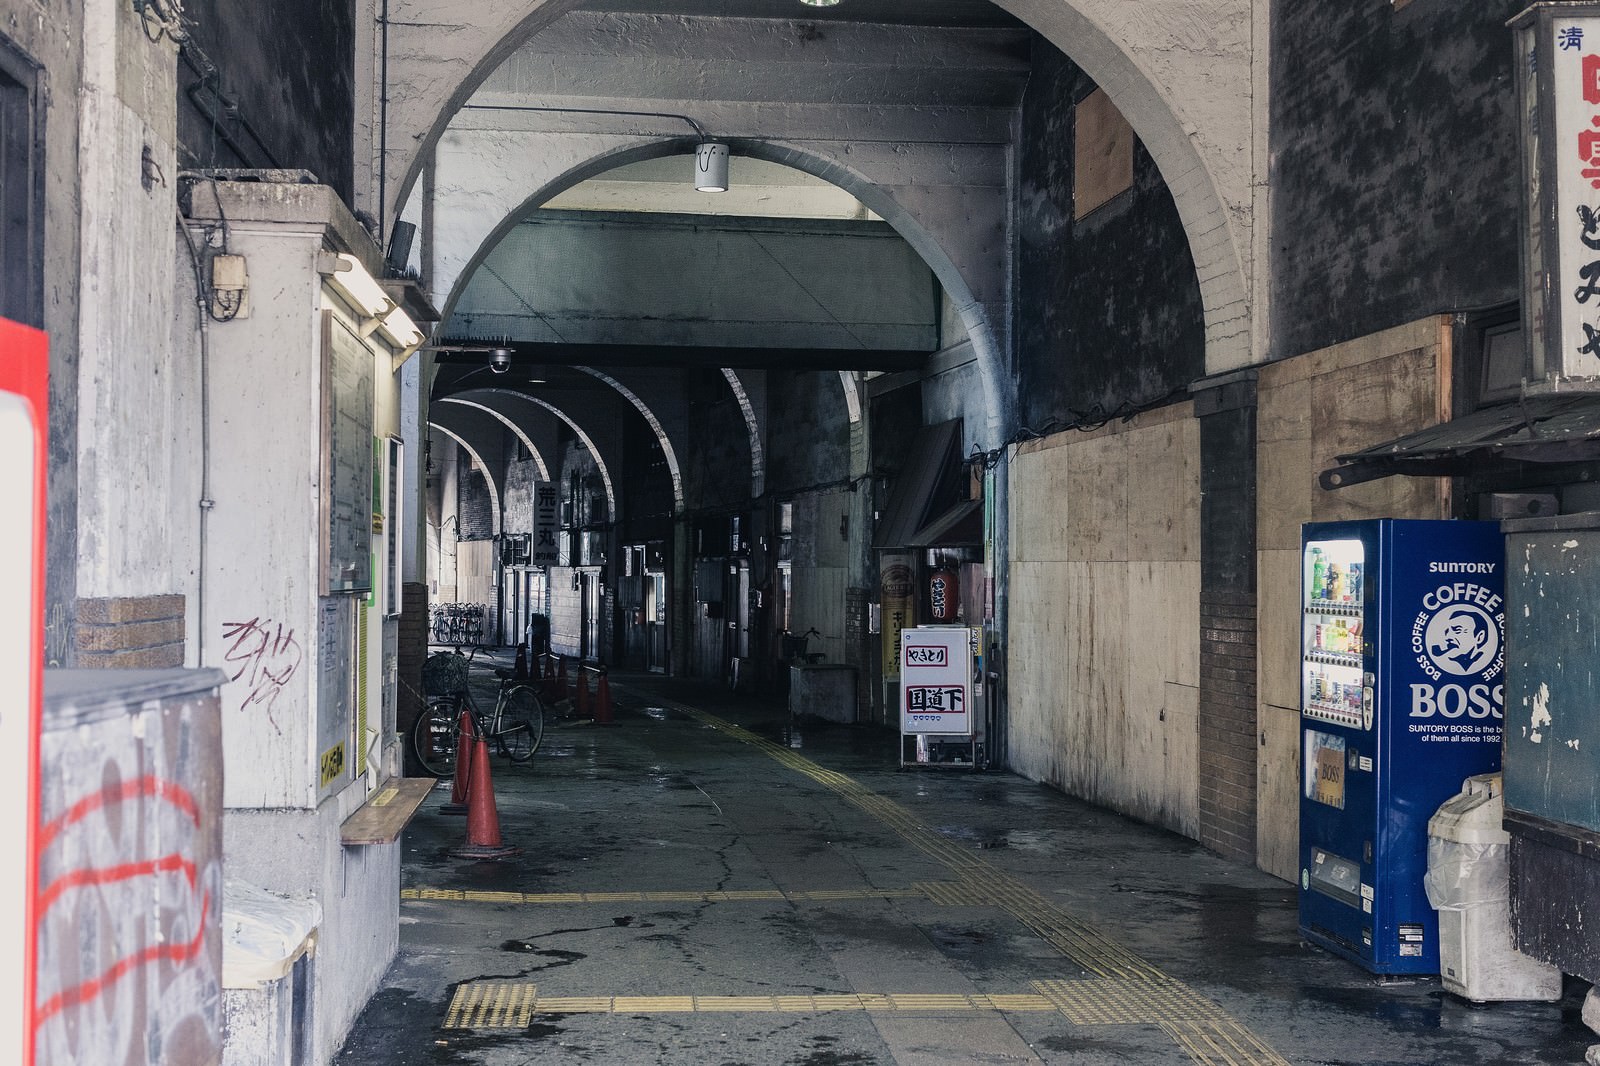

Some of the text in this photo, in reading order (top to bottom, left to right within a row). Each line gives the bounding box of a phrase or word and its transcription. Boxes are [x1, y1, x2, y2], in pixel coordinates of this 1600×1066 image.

[538, 486, 556, 546] 荒三丸
[1429, 561, 1496, 574] SUNTORY
[931, 578, 947, 618] やきとり
[1422, 582, 1503, 612] COFFEE
[908, 648, 944, 662] やきとり
[1411, 611, 1442, 681] BOSS COFFEE
[909, 688, 963, 711] 国道下
[1408, 724, 1449, 733] SUNTORY
[1450, 725, 1474, 733] BOSS
[1482, 726, 1495, 734] the
[1421, 734, 1430, 742] of
[1460, 735, 1481, 743] since
[1482, 735, 1501, 743] 1992
[1322, 762, 1340, 784] BOSS
